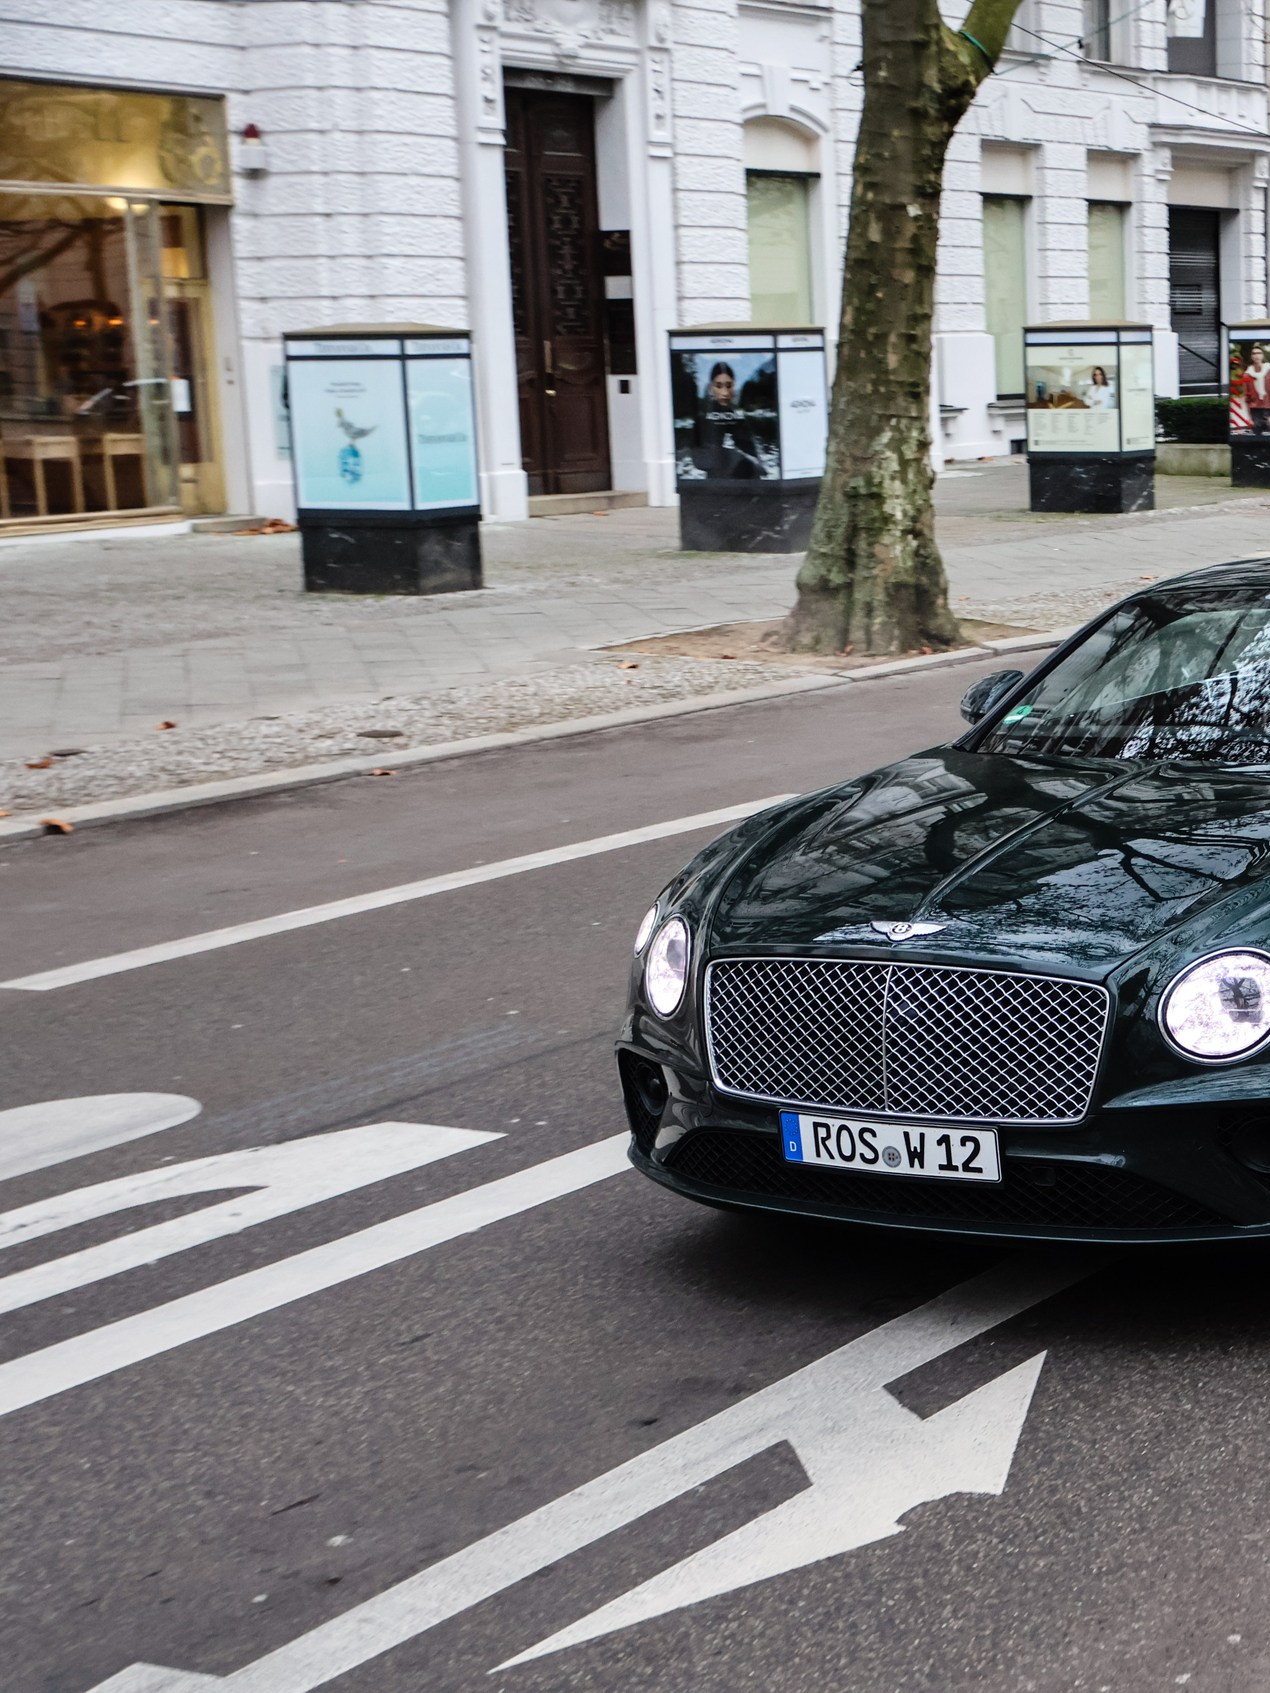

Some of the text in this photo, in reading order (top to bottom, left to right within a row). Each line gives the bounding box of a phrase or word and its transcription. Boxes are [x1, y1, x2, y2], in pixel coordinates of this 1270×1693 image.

[789, 1141, 797, 1151] D
[812, 1121, 983, 1174] ROS W 12
